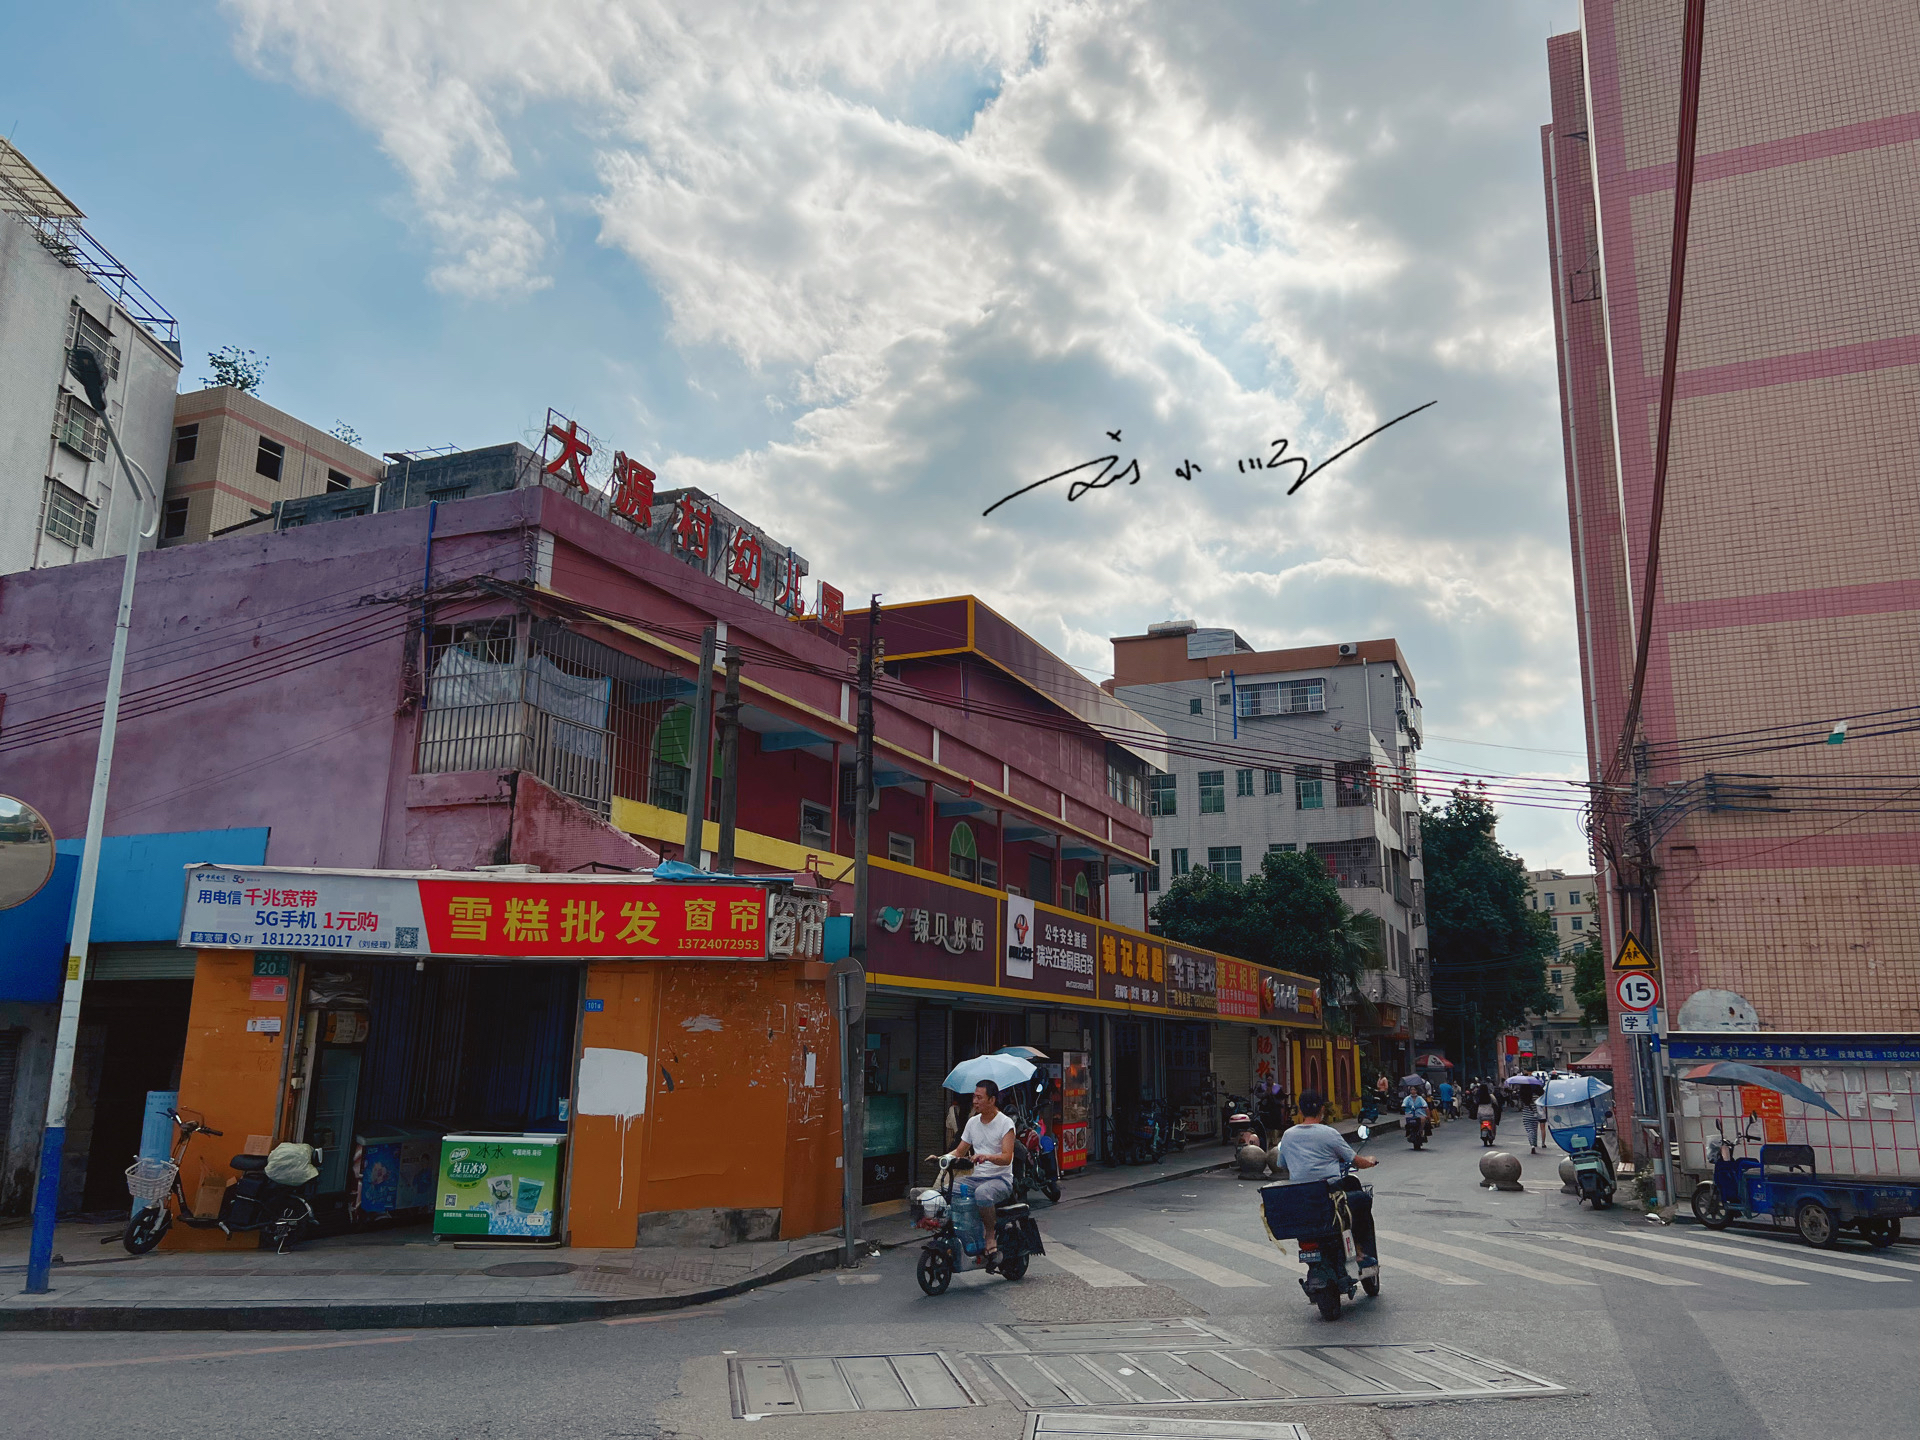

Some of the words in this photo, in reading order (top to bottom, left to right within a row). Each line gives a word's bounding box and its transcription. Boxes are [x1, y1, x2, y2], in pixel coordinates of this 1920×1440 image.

[544, 420, 844, 635] 大源村幼儿园
[255, 911, 317, 929] 5G手机
[323, 911, 378, 932] 1元购
[448, 896, 660, 945] 雪糕批发
[685, 898, 762, 932] 窗帘
[772, 891, 828, 958] 窗帘
[193, 933, 226, 943] 装宽带
[244, 934, 254, 944] 打
[262, 933, 352, 948] 18122321017
[913, 908, 985, 955] 绿贝烘焙
[1045, 924, 1088, 950] 公牛安全插座
[677, 938, 760, 951] 13724072953
[1036, 944, 1094, 976] 瑞兴五金厨具百货
[1625, 982, 1651, 1002] 15
[1694, 1045, 1829, 1058] 大源村公告信息栏
[476, 1143, 506, 1160] 冰水
[453, 1162, 488, 1174] 绿豆冰沙
